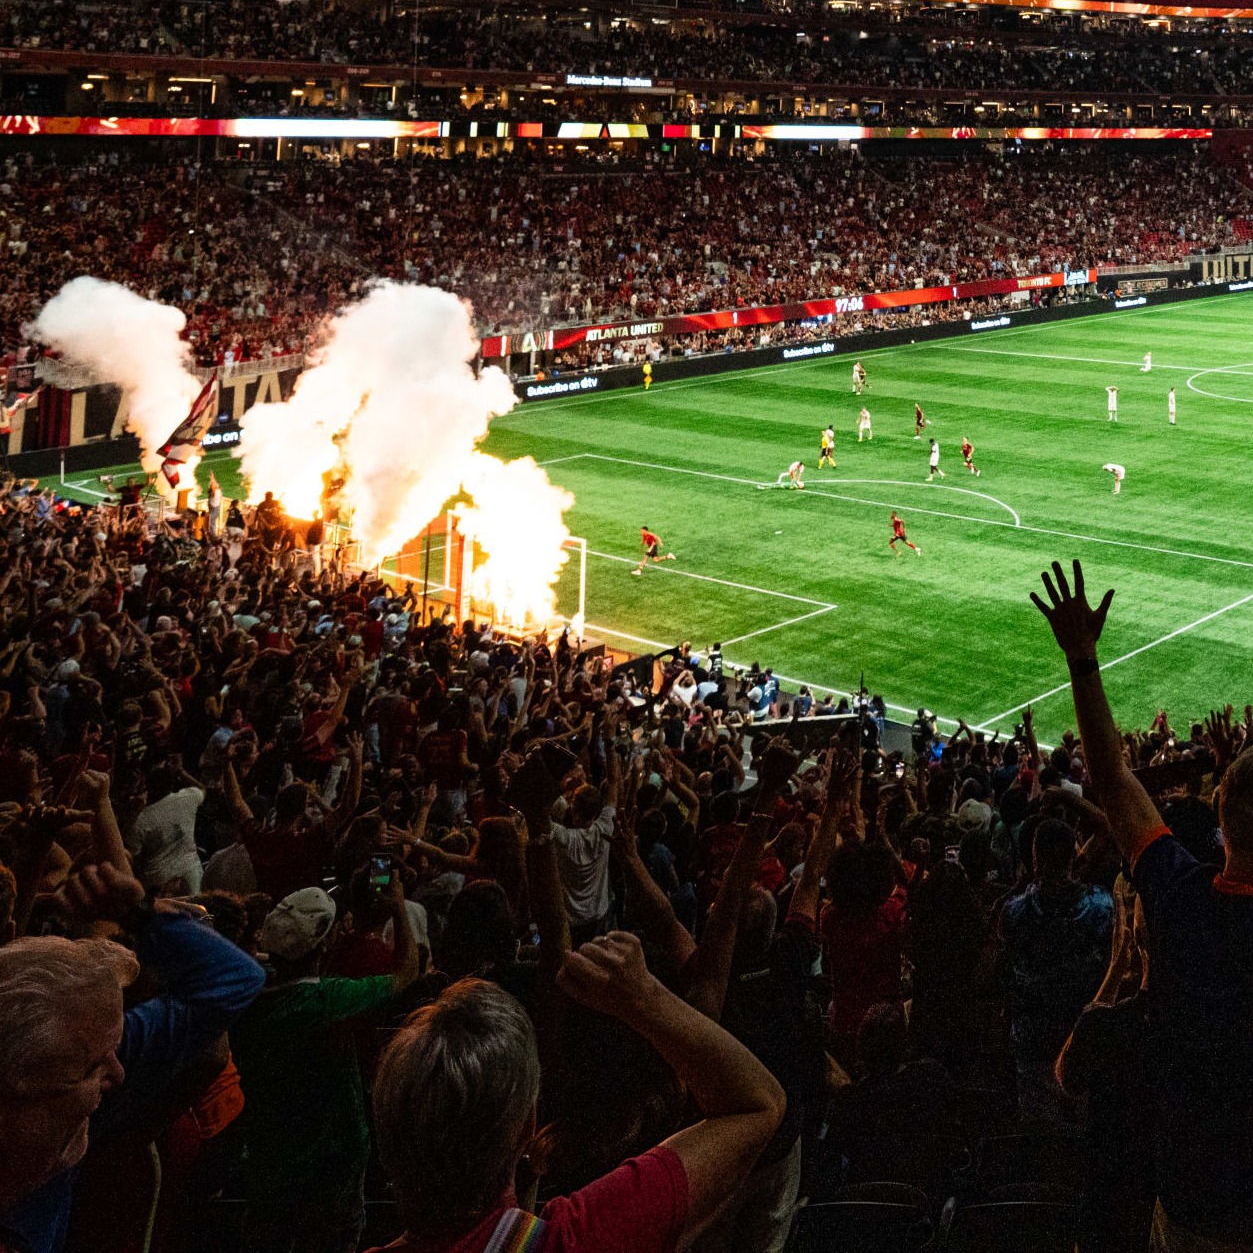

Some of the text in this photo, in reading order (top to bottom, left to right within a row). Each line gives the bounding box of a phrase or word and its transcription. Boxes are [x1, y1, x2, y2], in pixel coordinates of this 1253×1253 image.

[835, 297, 864, 313] 97:06
[733, 312, 738, 324] 1
[585, 322, 664, 341] ATLANTA UNITED
[527, 382, 569, 397] Subscribe
[568, 380, 580, 390] on
